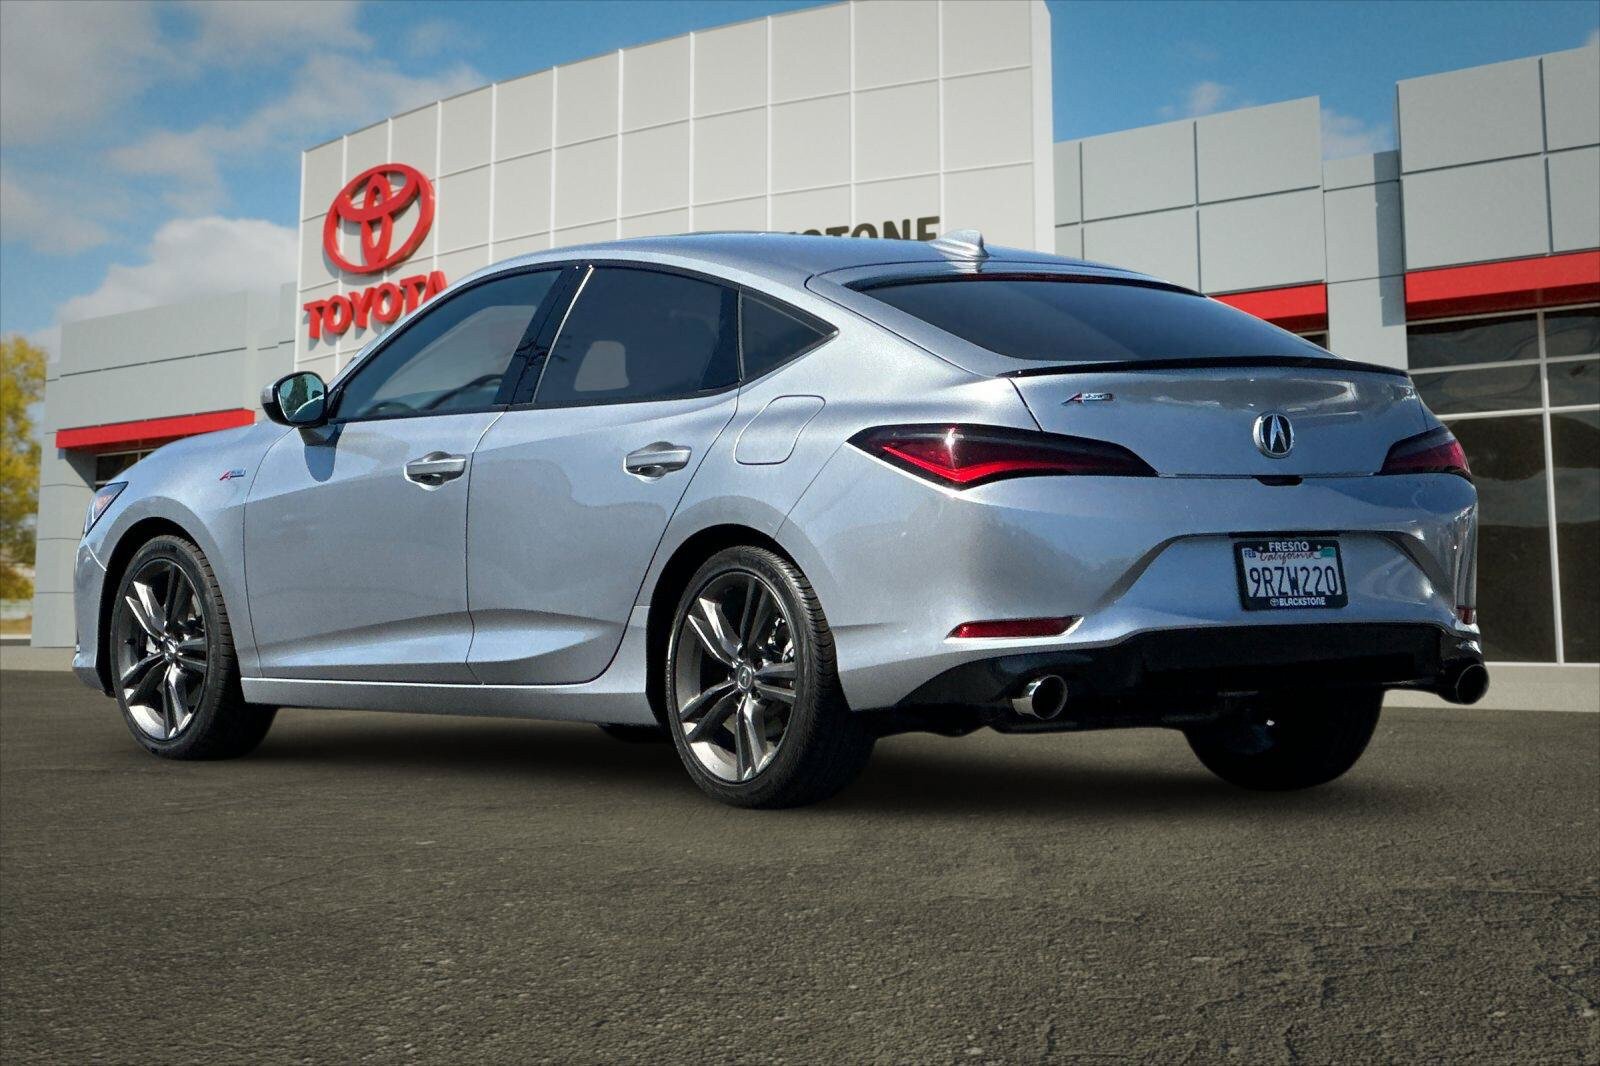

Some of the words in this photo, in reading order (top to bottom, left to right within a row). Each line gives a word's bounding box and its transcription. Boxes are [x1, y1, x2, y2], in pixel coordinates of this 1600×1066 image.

[304, 271, 447, 339] TOYOTA
[1268, 541, 1310, 552] FRESNO
[1249, 565, 1338, 597] 9RZW220
[1279, 597, 1326, 606] BLACKSTONE
